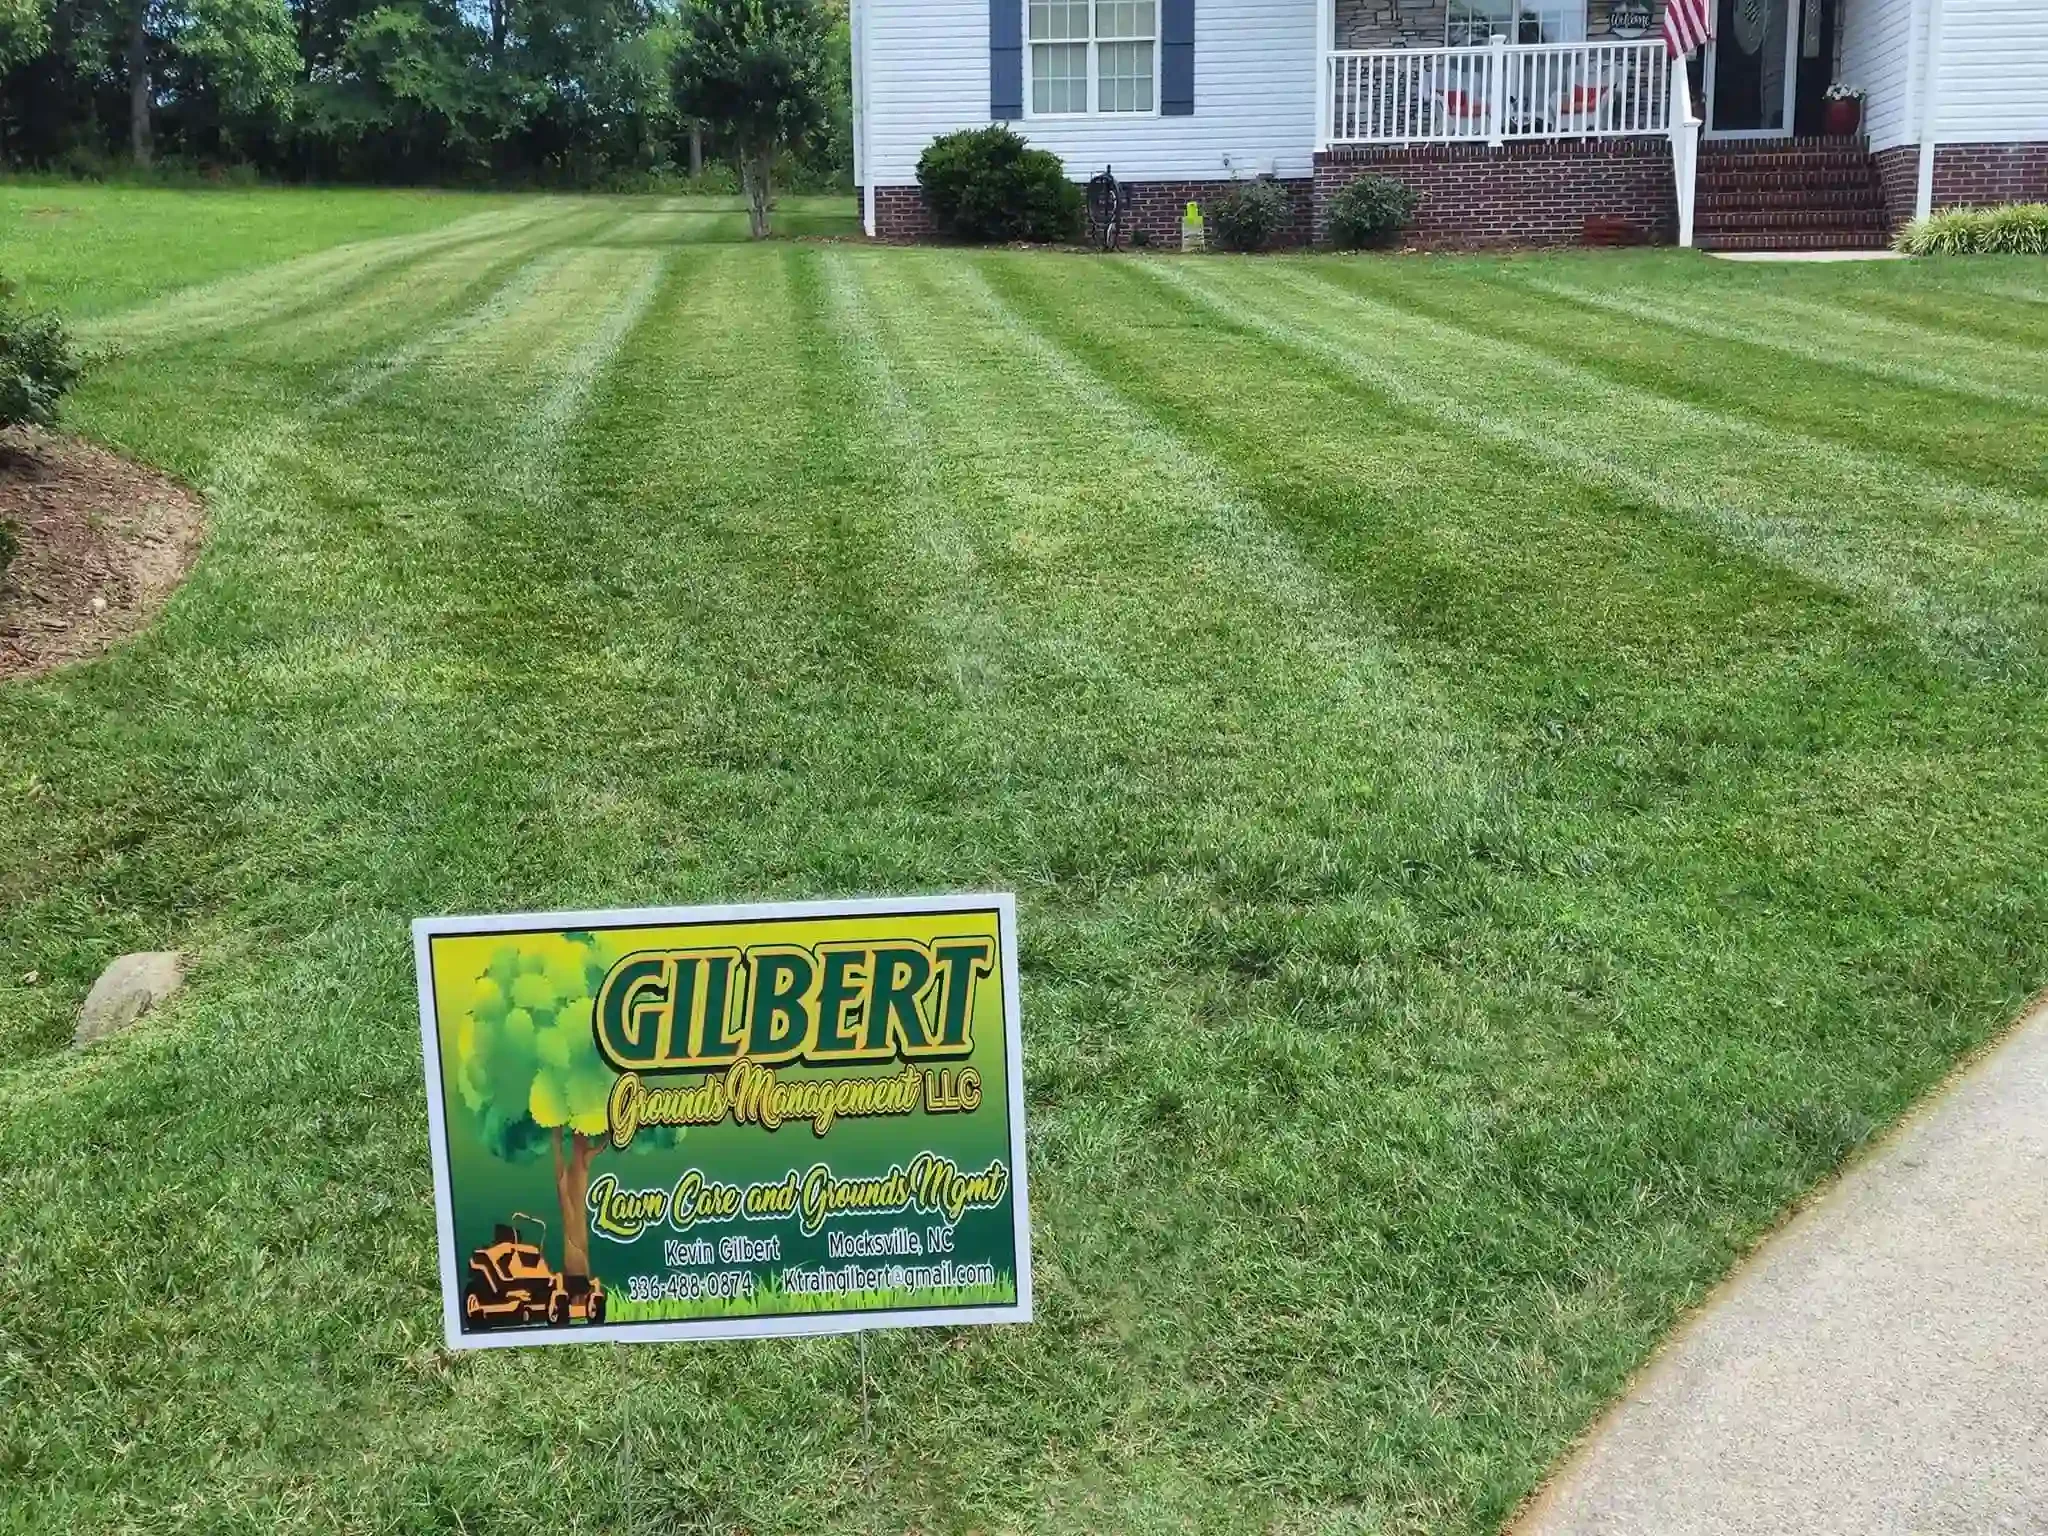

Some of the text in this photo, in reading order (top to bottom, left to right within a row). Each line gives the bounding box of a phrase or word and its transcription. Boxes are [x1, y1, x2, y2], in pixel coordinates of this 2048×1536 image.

[593, 936, 994, 1071] GILBERT
[610, 1058, 982, 1147] Grounds Management LLC
[587, 1151, 1008, 1243] Lawn Care and Grounds Mgmt
[664, 1234, 780, 1266] Kevin Gilbert
[828, 1226, 954, 1257] Mocksville, NC
[628, 1271, 752, 1300] 336-488-0874
[783, 1259, 994, 1297] Ktraingilbert@gmail.com
